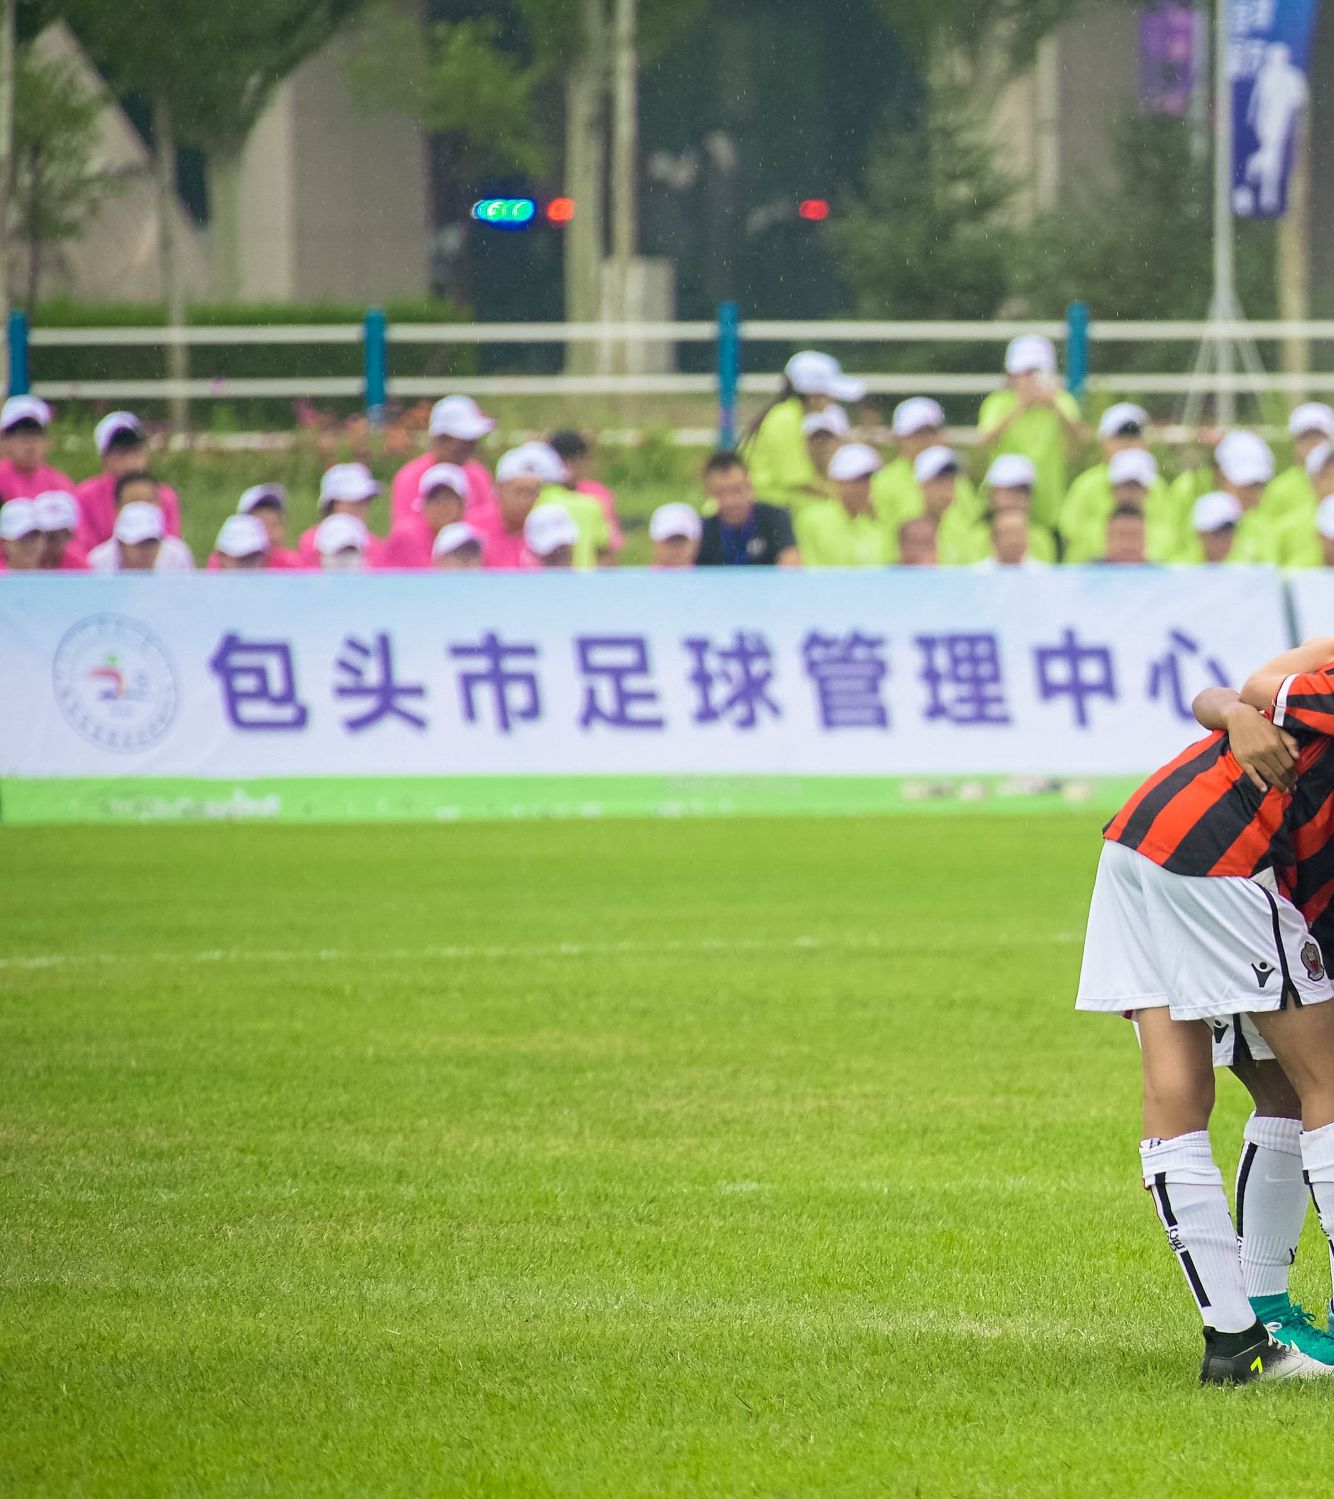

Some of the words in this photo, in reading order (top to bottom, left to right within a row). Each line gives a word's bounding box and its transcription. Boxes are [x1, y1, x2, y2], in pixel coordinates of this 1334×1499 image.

[208, 627, 1231, 736] 包头市足球管理中心
